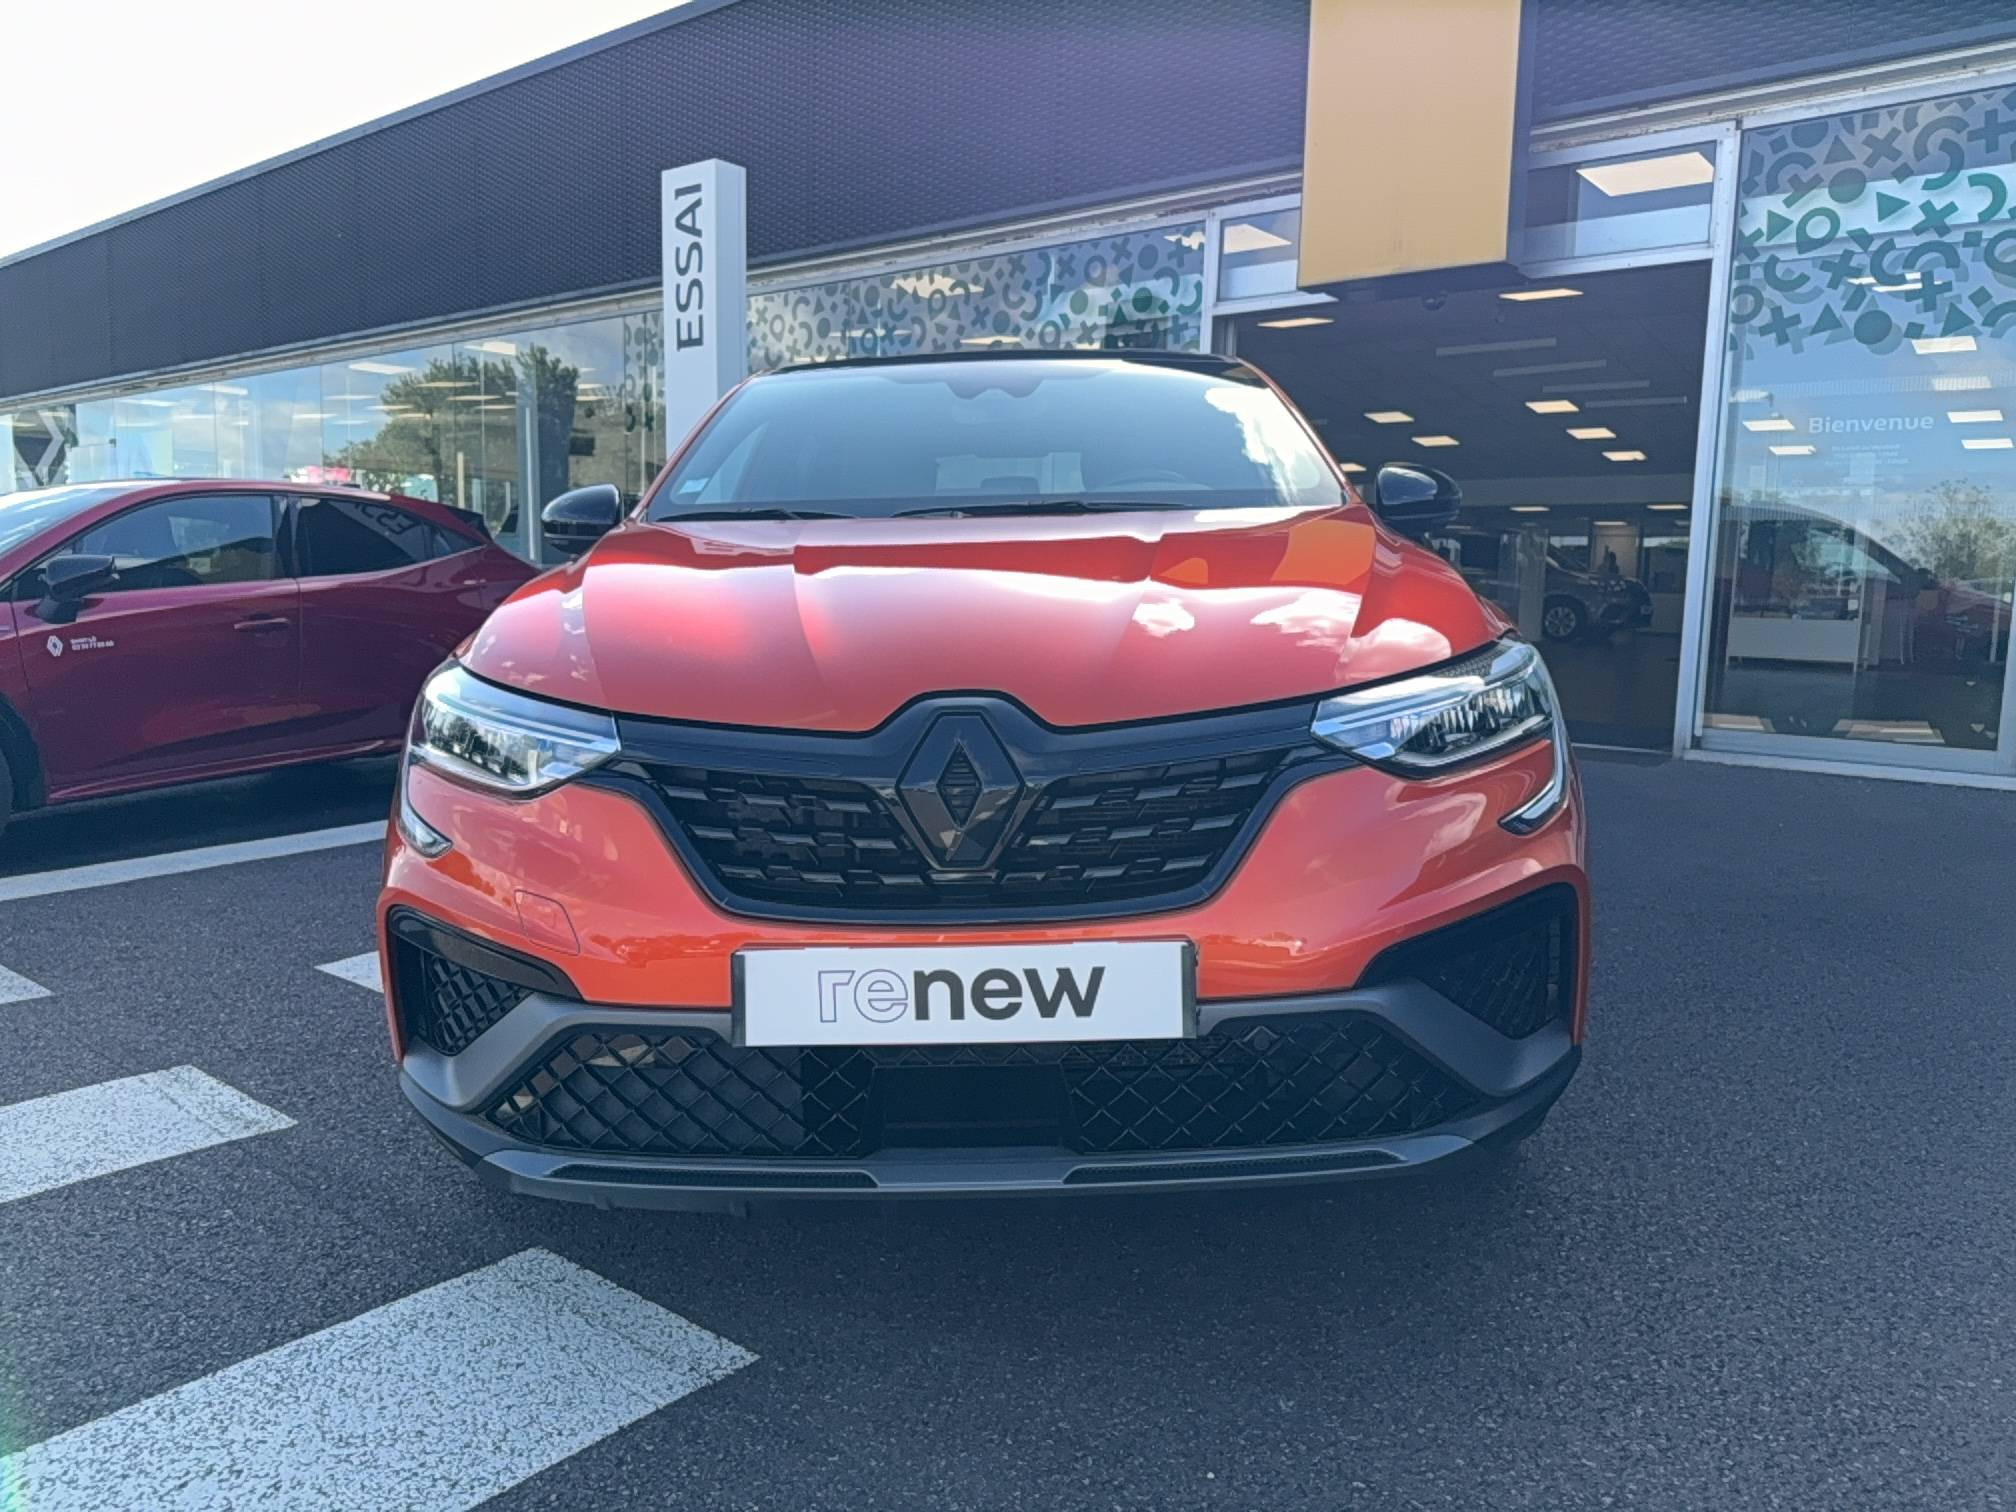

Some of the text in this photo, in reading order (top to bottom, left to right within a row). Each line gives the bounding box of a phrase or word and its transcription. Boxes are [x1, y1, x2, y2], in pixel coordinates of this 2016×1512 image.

[674, 183, 704, 352] ESSAI
[1808, 415, 1935, 434] Bienvenue
[817, 965, 1106, 1024] renew
